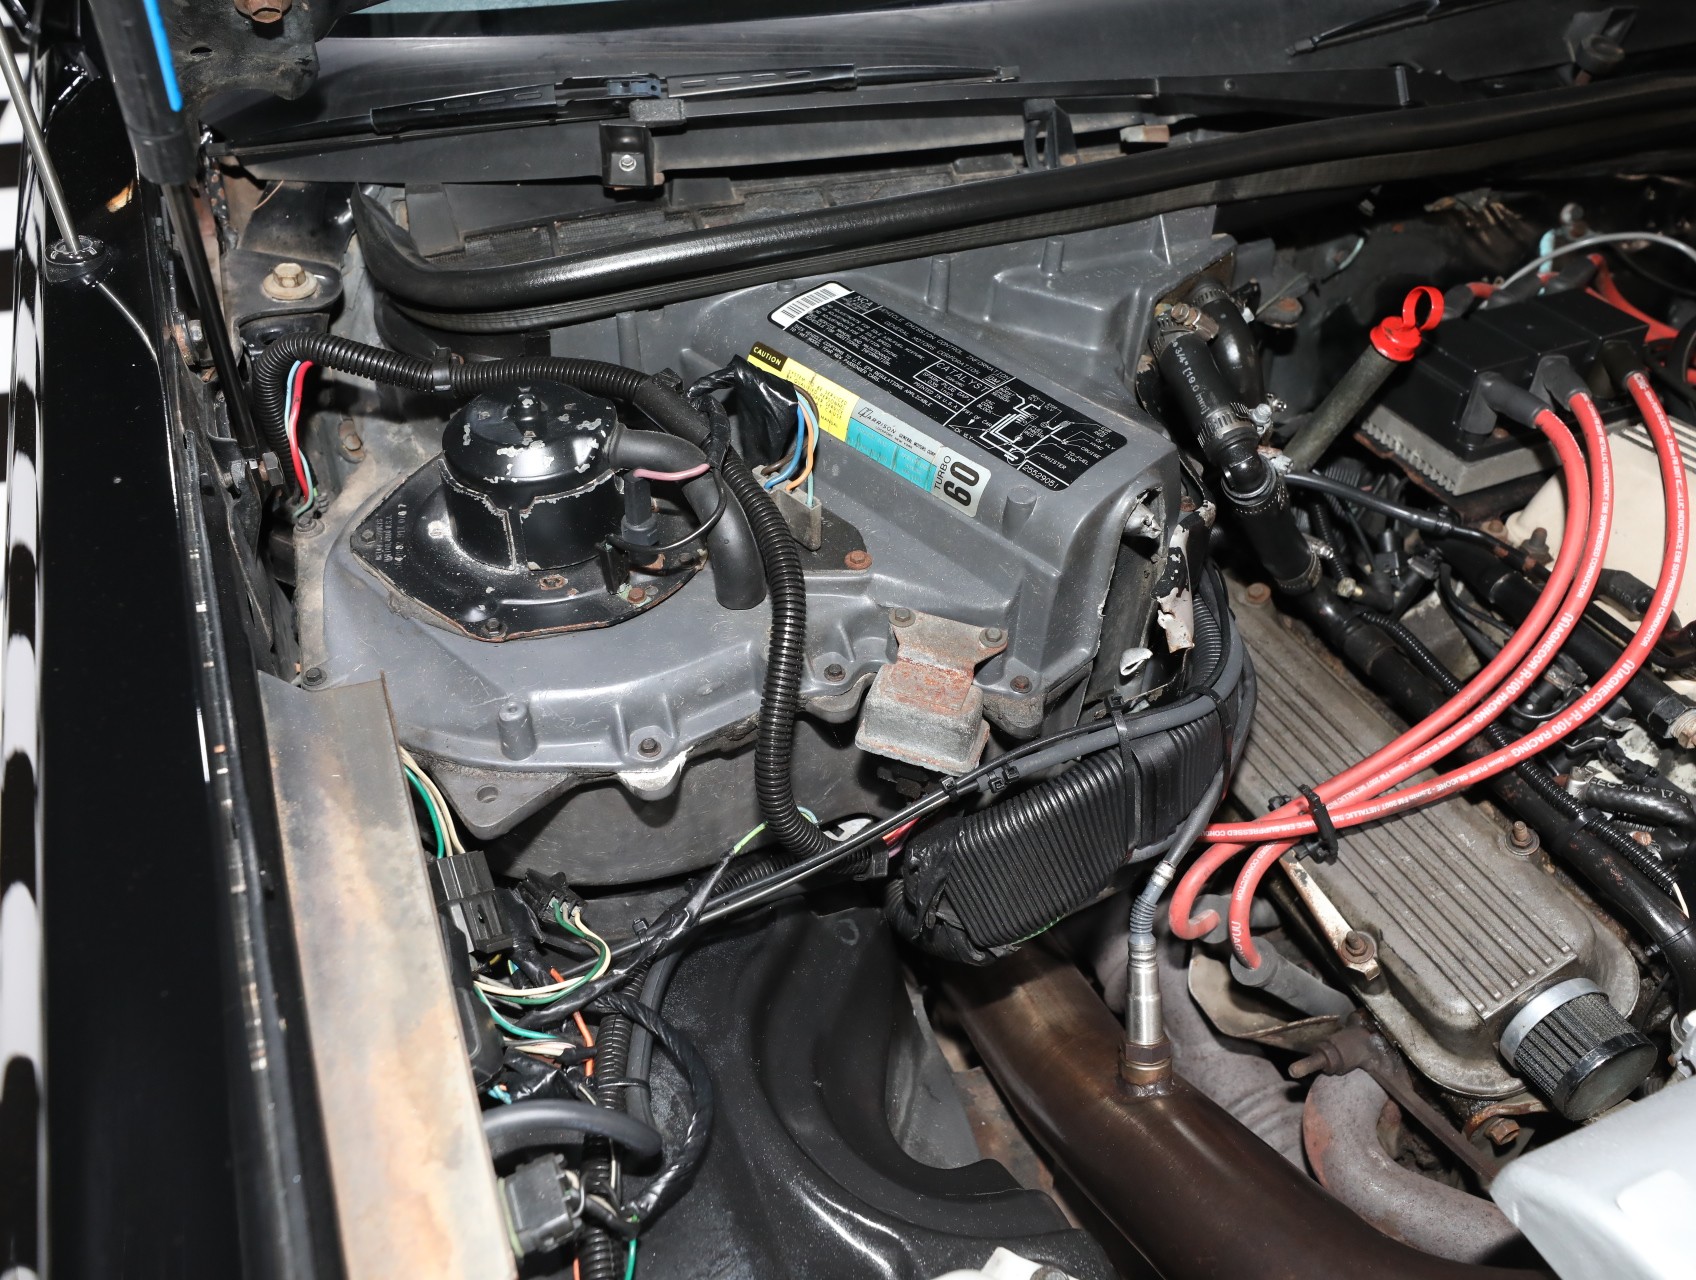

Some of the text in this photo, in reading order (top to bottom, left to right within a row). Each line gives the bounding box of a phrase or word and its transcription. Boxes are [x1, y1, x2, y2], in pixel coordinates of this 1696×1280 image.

[853, 295, 873, 306] NCA
[828, 310, 855, 327] ADJUSTMENTS
[864, 331, 876, 339] IDLE
[834, 308, 861, 324] ADJUSTMENTS
[870, 328, 882, 336] IDLE
[817, 318, 836, 329] SERVICE
[862, 343, 892, 361] MAINTENANCE
[835, 332, 859, 348] ADDITIONAL
[858, 334, 880, 347] IGNITION
[877, 306, 1011, 380] VEHICLE EMISSION CONTROL INFORMATION
[883, 320, 980, 375] GENERAL MOTORS CORPORATION
[753, 346, 782, 366] CAUTION
[793, 323, 805, 331] THIS
[804, 331, 824, 342] VEHICLE
[822, 340, 845, 355] CONFORMS
[851, 358, 863, 366] U.S.
[873, 370, 904, 390] REGULATIONS
[902, 389, 932, 407] APPLICABLE
[807, 337, 820, 346] MODEL
[822, 345, 833, 354] YEAR
[842, 358, 867, 374] PASSENGER
[912, 381, 934, 395] PRINTED
[922, 371, 940, 383] SPARK
[940, 382, 956, 392] PLUG
[936, 362, 989, 393] CATALYST
[1182, 366, 1199, 392] [19.0
[1194, 392, 1210, 415] mm]
[825, 406, 842, 419] CAUSE
[981, 419, 992, 427] CAR
[1656, 414, 1670, 436] SILICONE
[857, 404, 898, 436] HARRISON
[898, 434, 912, 443] GENERAL
[913, 442, 926, 451] MOTORS
[1038, 452, 1066, 470] CANISTER
[1063, 453, 1077, 463] TANK
[1080, 446, 1101, 459] CRUISE
[1598, 436, 1608, 462] METALLIC
[933, 455, 951, 490] TURBO
[943, 461, 979, 506] 60
[1022, 464, 1058, 488] 25529051
[1601, 464, 1609, 500] INDUCTANCE
[1591, 515, 1608, 557] SUPPRESSED
[1675, 510, 1685, 550] INDUCTANCE
[1674, 550, 1682, 563] EMI
[1576, 558, 1598, 597] CONDUCTOR
[1660, 563, 1680, 606] SUPPRESSED
[1640, 607, 1666, 646] CONDUCTOR
[1527, 612, 1573, 671] MAGNECOR
[1505, 668, 1533, 695] R-100
[1580, 659, 1634, 714] MAGNECOR
[1473, 692, 1509, 723] RACING
[1551, 709, 1583, 735] R-100
[1411, 743, 1440, 764] SILICONE
[1438, 734, 1456, 747] PURE
[1511, 729, 1552, 757] RACING
[1435, 773, 1468, 791] SILICONE
[1468, 764, 1488, 778] PURE
[1337, 784, 1366, 804] METALLIC
[1345, 804, 1380, 820] METALLIC
[1235, 858, 1259, 900] CONDUCTOR
